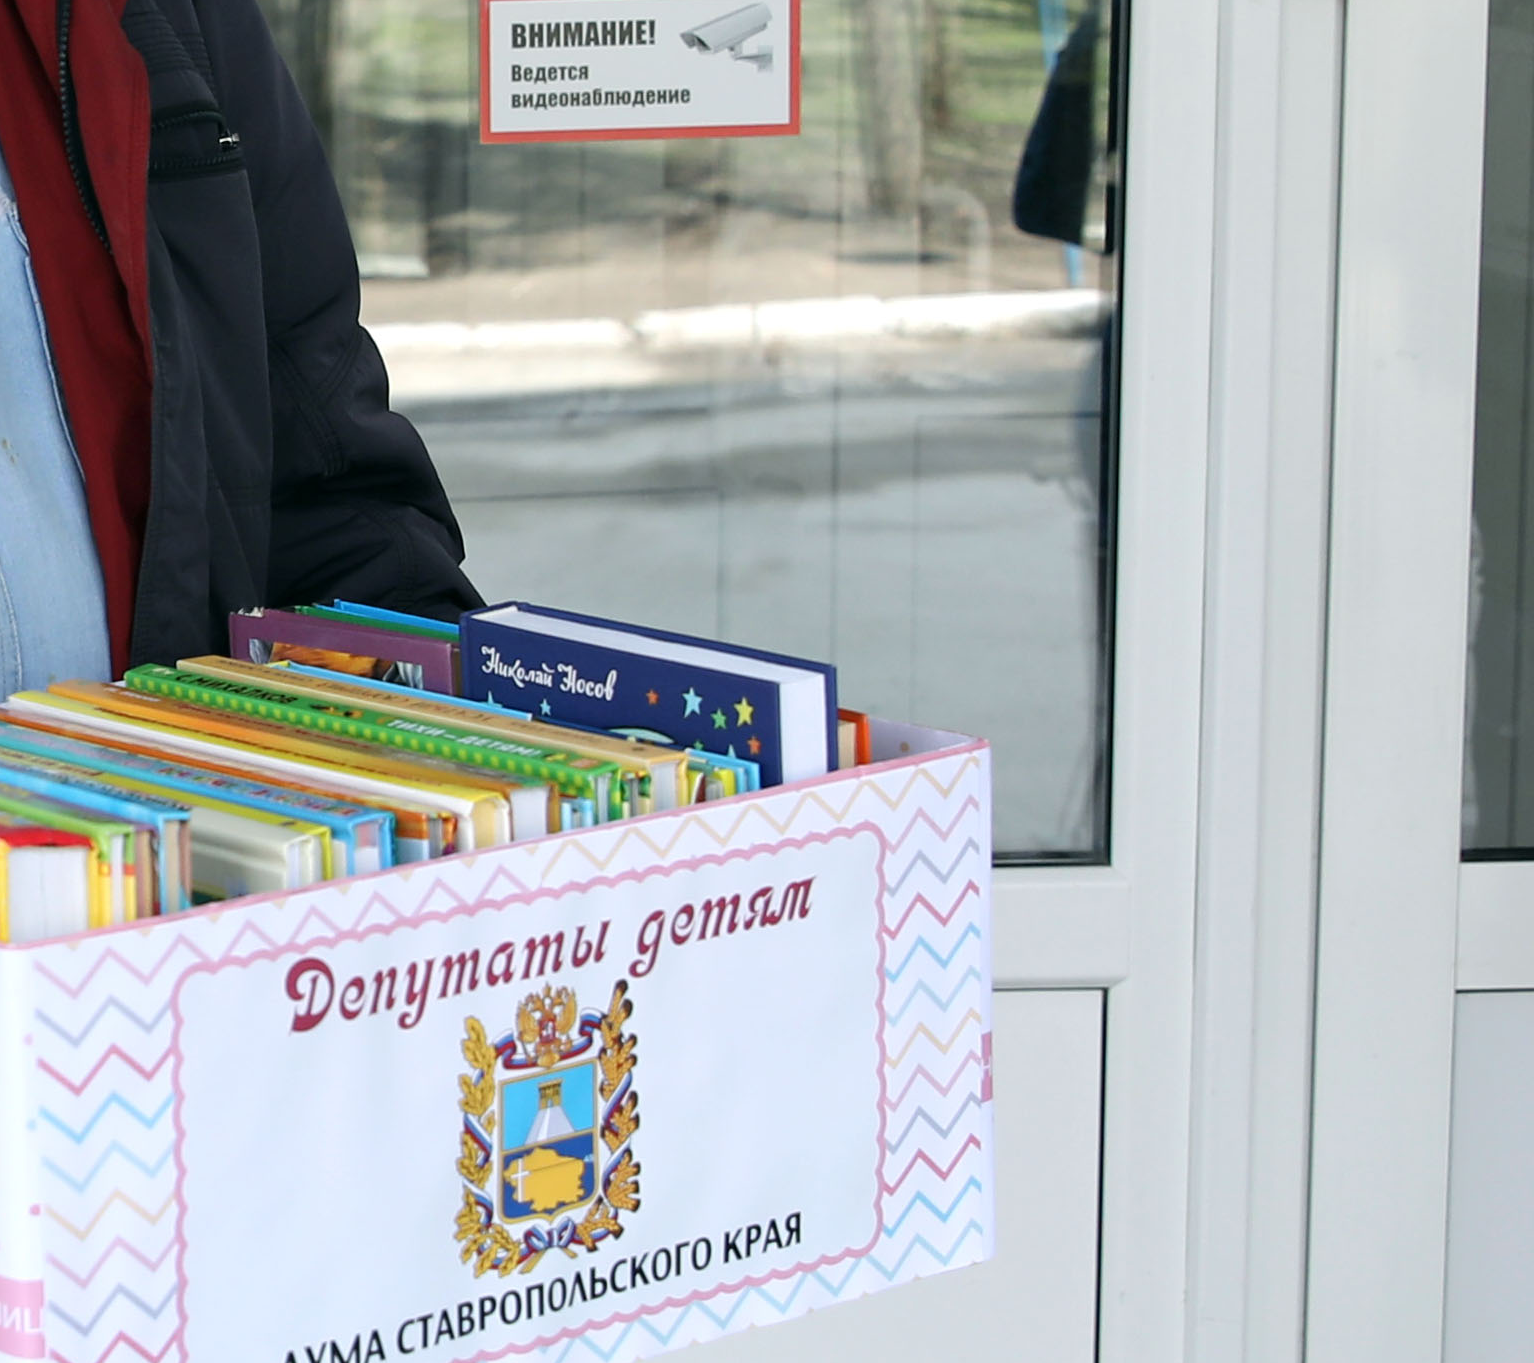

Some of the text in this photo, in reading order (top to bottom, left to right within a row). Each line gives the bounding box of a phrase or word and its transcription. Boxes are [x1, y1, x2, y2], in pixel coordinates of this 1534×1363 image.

[511, 19, 656, 49] ВНИМАНИЕ!
[511, 64, 589, 84] Ведется
[511, 87, 691, 110] видеонаблюдение
[480, 645, 618, 702] Николай Носов
[285, 875, 817, 1033] Депутаты детям
[396, 1237, 712, 1355] СТАВРОПОЛЬСКОГО
[722, 1212, 803, 1264] КРАЯ
